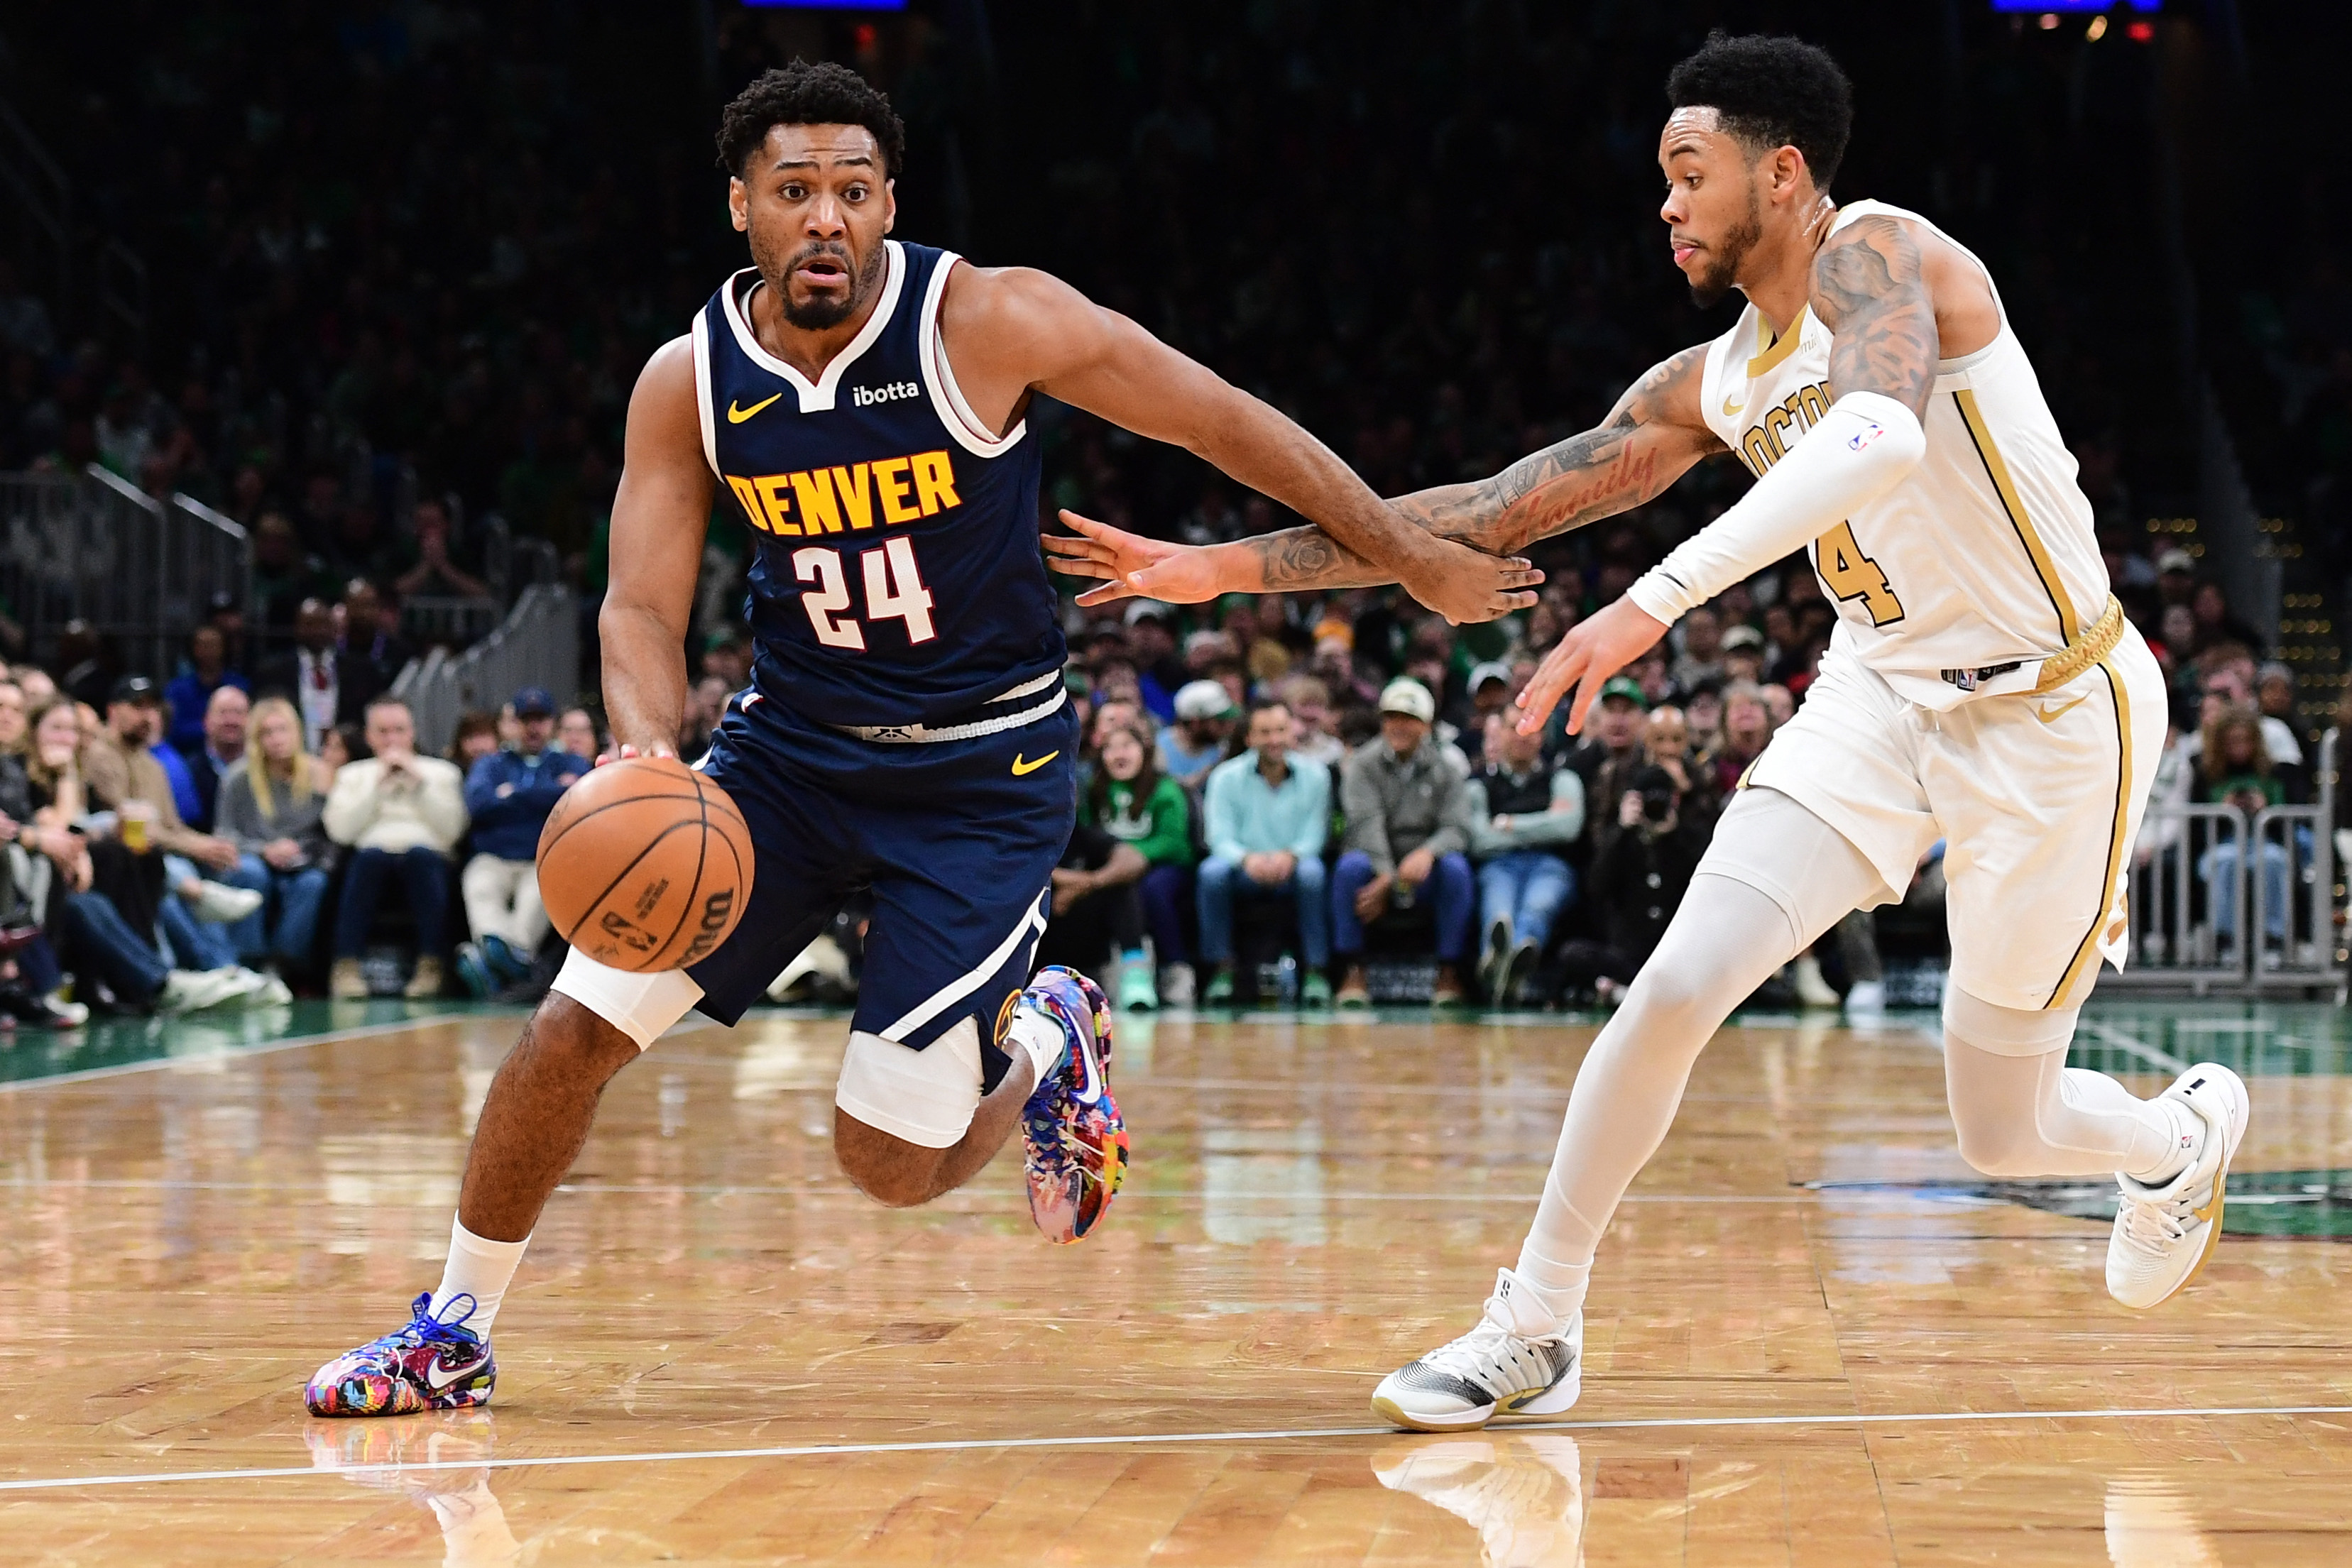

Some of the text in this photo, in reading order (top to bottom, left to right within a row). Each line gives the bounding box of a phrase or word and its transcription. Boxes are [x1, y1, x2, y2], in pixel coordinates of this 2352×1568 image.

[853, 381, 919, 407] ibotta
[724, 449, 963, 535] DENVER
[790, 534, 939, 652] 24
[1815, 519, 1905, 628] 4
